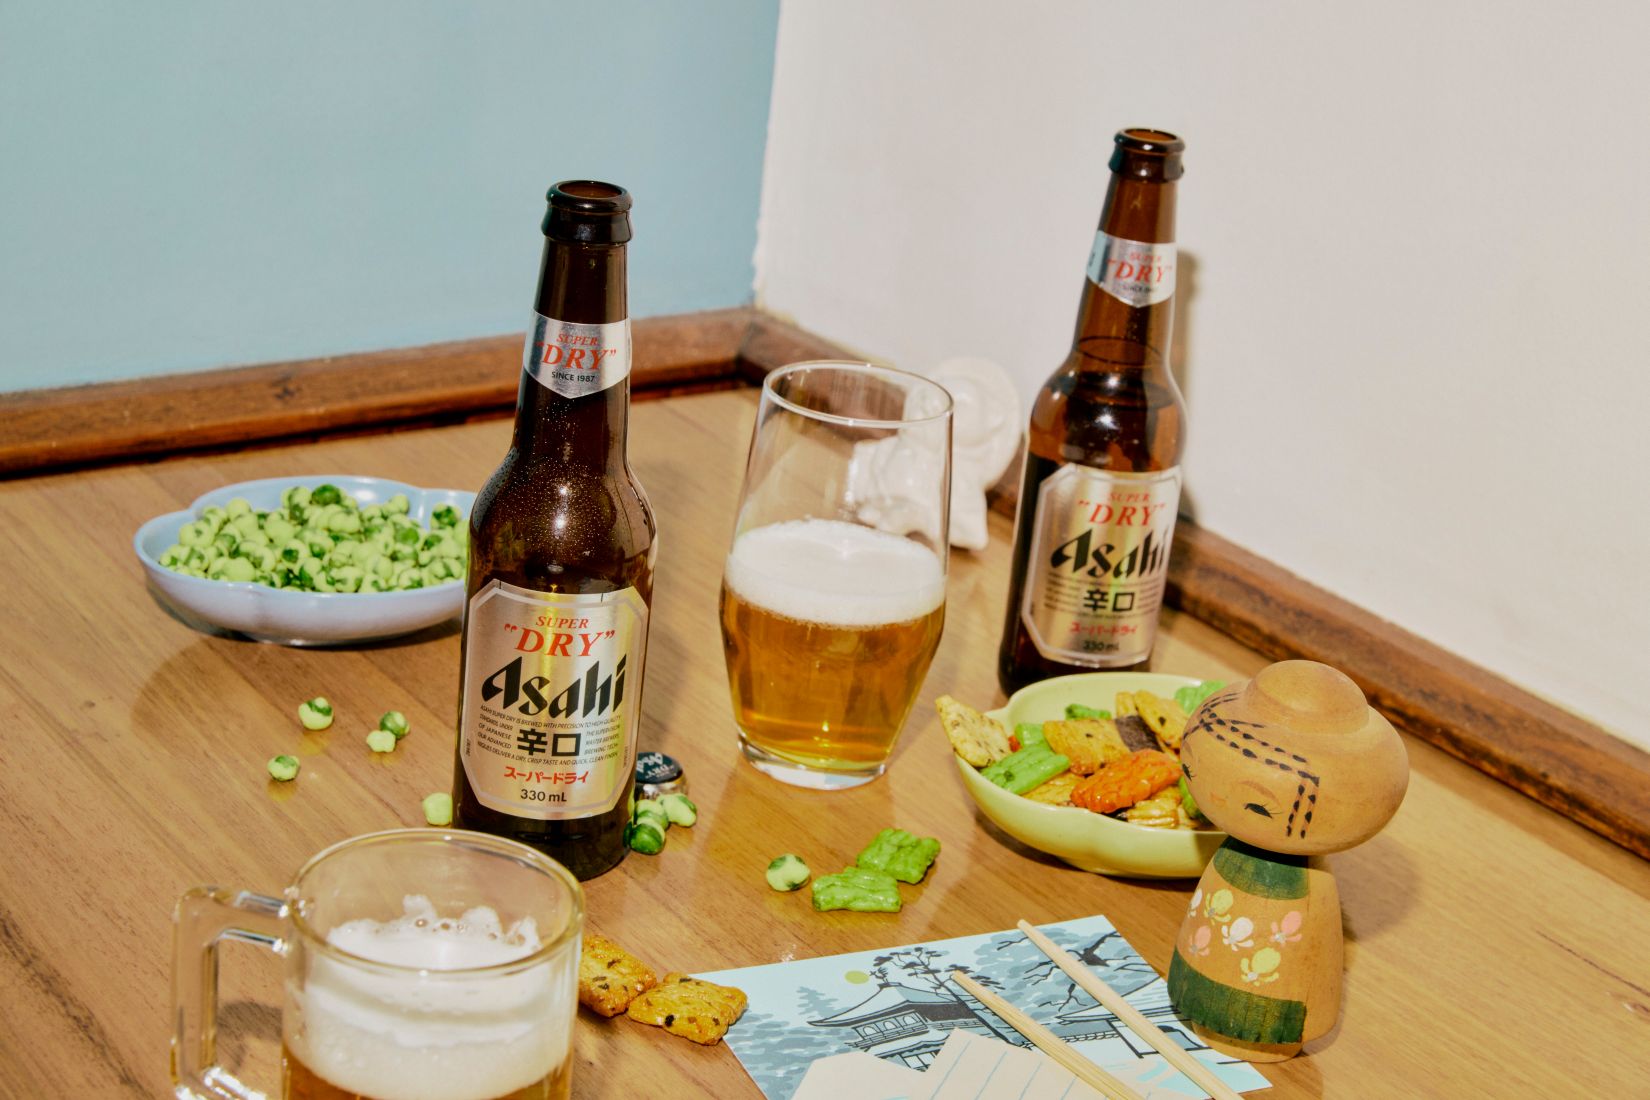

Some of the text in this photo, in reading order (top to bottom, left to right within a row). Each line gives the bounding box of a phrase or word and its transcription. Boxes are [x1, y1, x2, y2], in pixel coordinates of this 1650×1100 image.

[556, 333, 598, 346] SUPER
[551, 371, 595, 383] SINCE 1987
[1110, 492, 1150, 503] SUPER
[1051, 524, 1169, 579] Asahi
[1083, 589, 1135, 612] 辛口
[536, 616, 589, 629] SUPER
[482, 654, 626, 718] Asahi
[521, 720, 542, 728] BREWED
[486, 727, 512, 740] JAPANESE
[487, 736, 512, 749] ADVANCED
[517, 729, 581, 757] 辛口
[504, 766, 589, 785] スーパードライ
[521, 789, 567, 803] 330 mL
